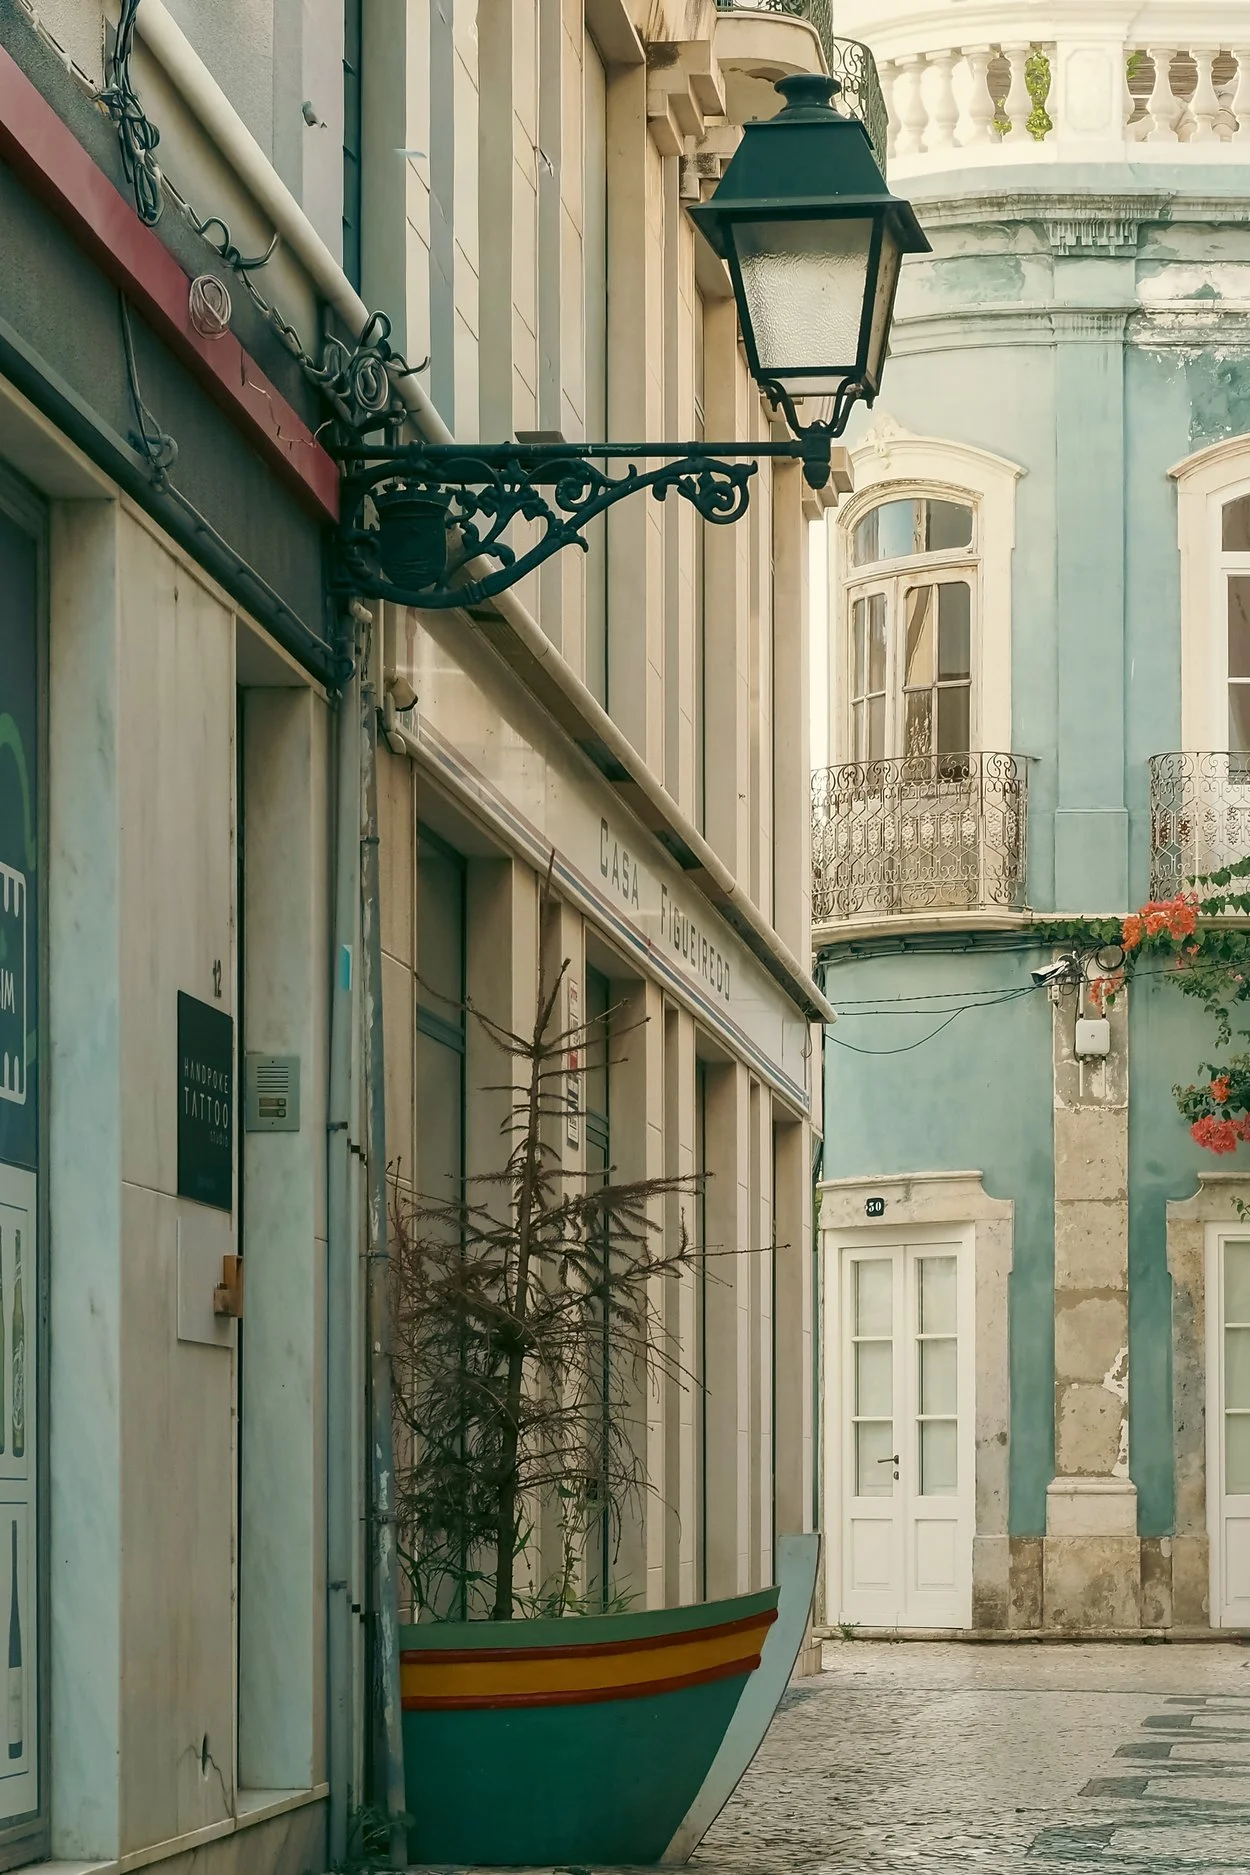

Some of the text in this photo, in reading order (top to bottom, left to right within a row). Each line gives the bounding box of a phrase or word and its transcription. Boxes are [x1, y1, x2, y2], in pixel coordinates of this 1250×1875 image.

[600, 817, 730, 1001] CASA FIGUEIREDO
[184, 1057, 229, 1094] HANDPOKE
[184, 1086, 229, 1129] TATTOO
